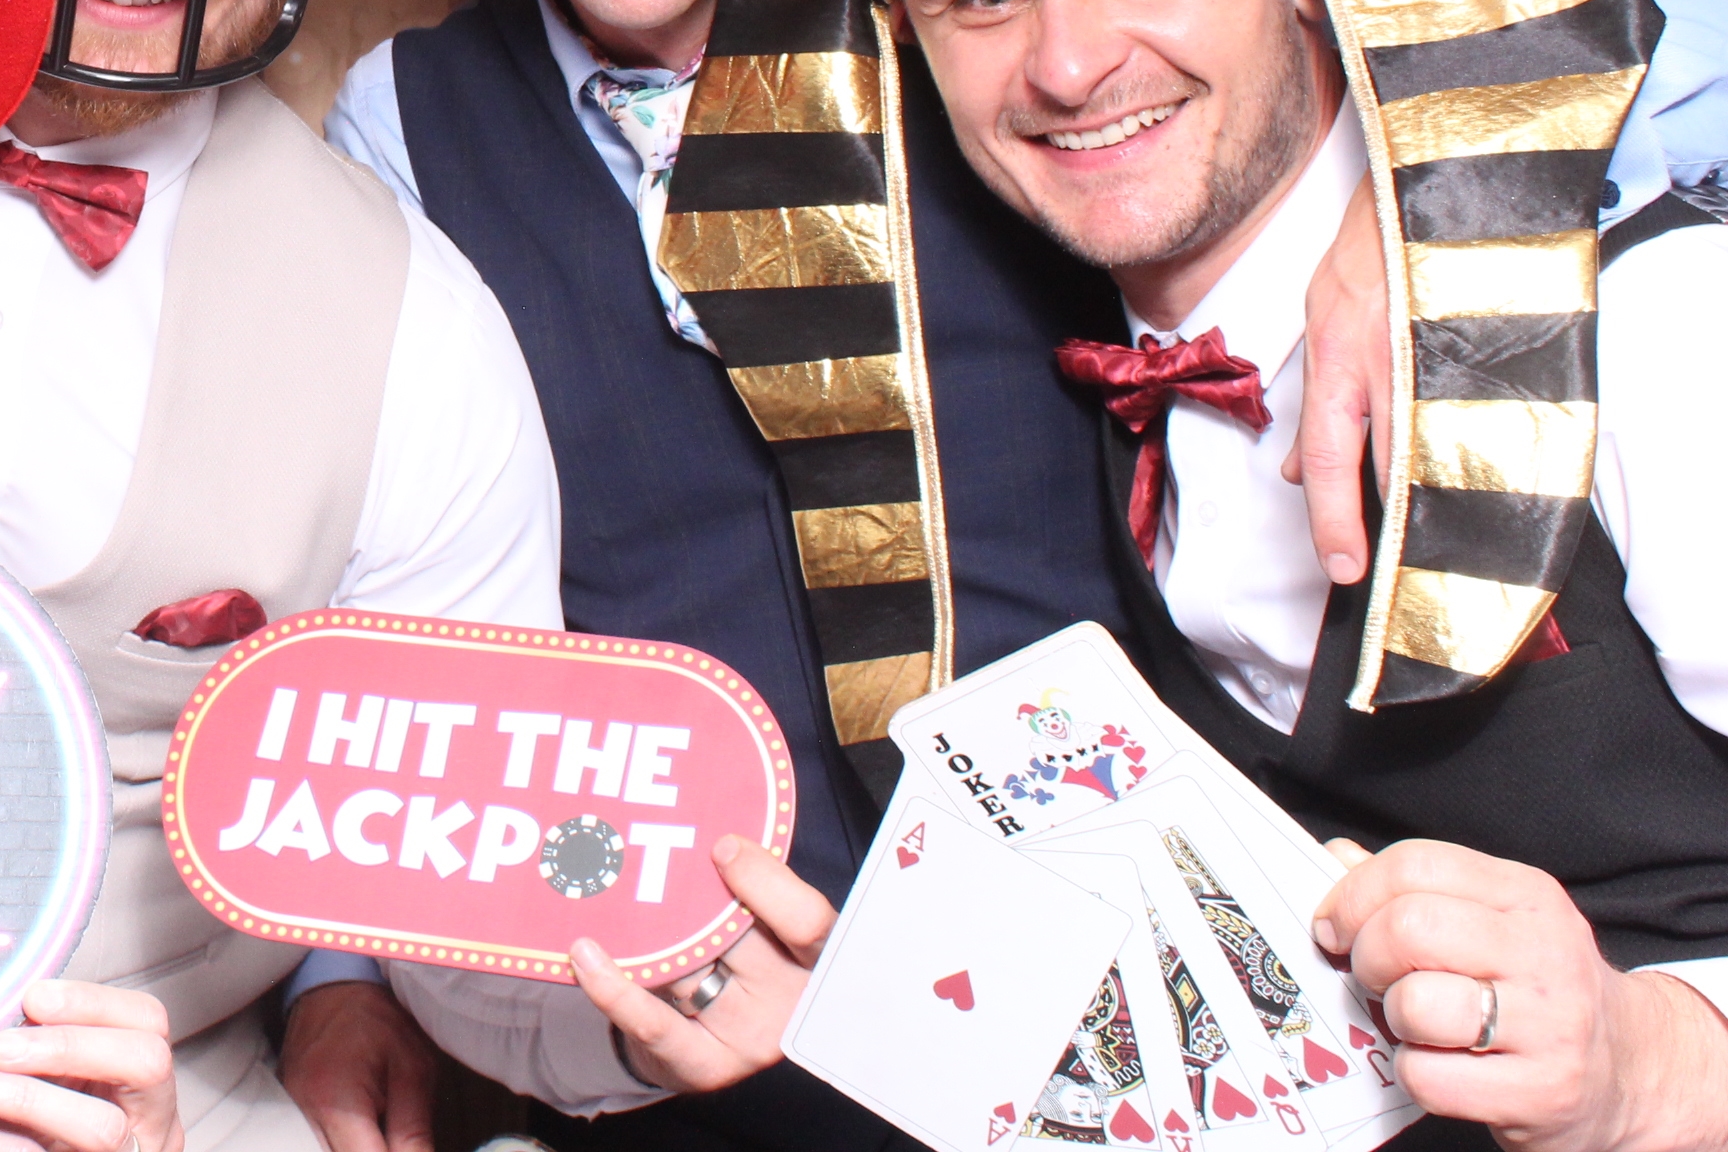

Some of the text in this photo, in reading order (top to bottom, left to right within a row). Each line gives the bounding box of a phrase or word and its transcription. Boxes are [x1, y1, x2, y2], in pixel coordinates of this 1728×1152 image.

[257, 687, 691, 808] I HIT THE
[932, 732, 1025, 838] JOKER
[218, 777, 696, 904] JACKPOT
[901, 820, 926, 853] A
[1366, 1049, 1395, 1088] J
[1269, 1101, 1306, 1136] Q
